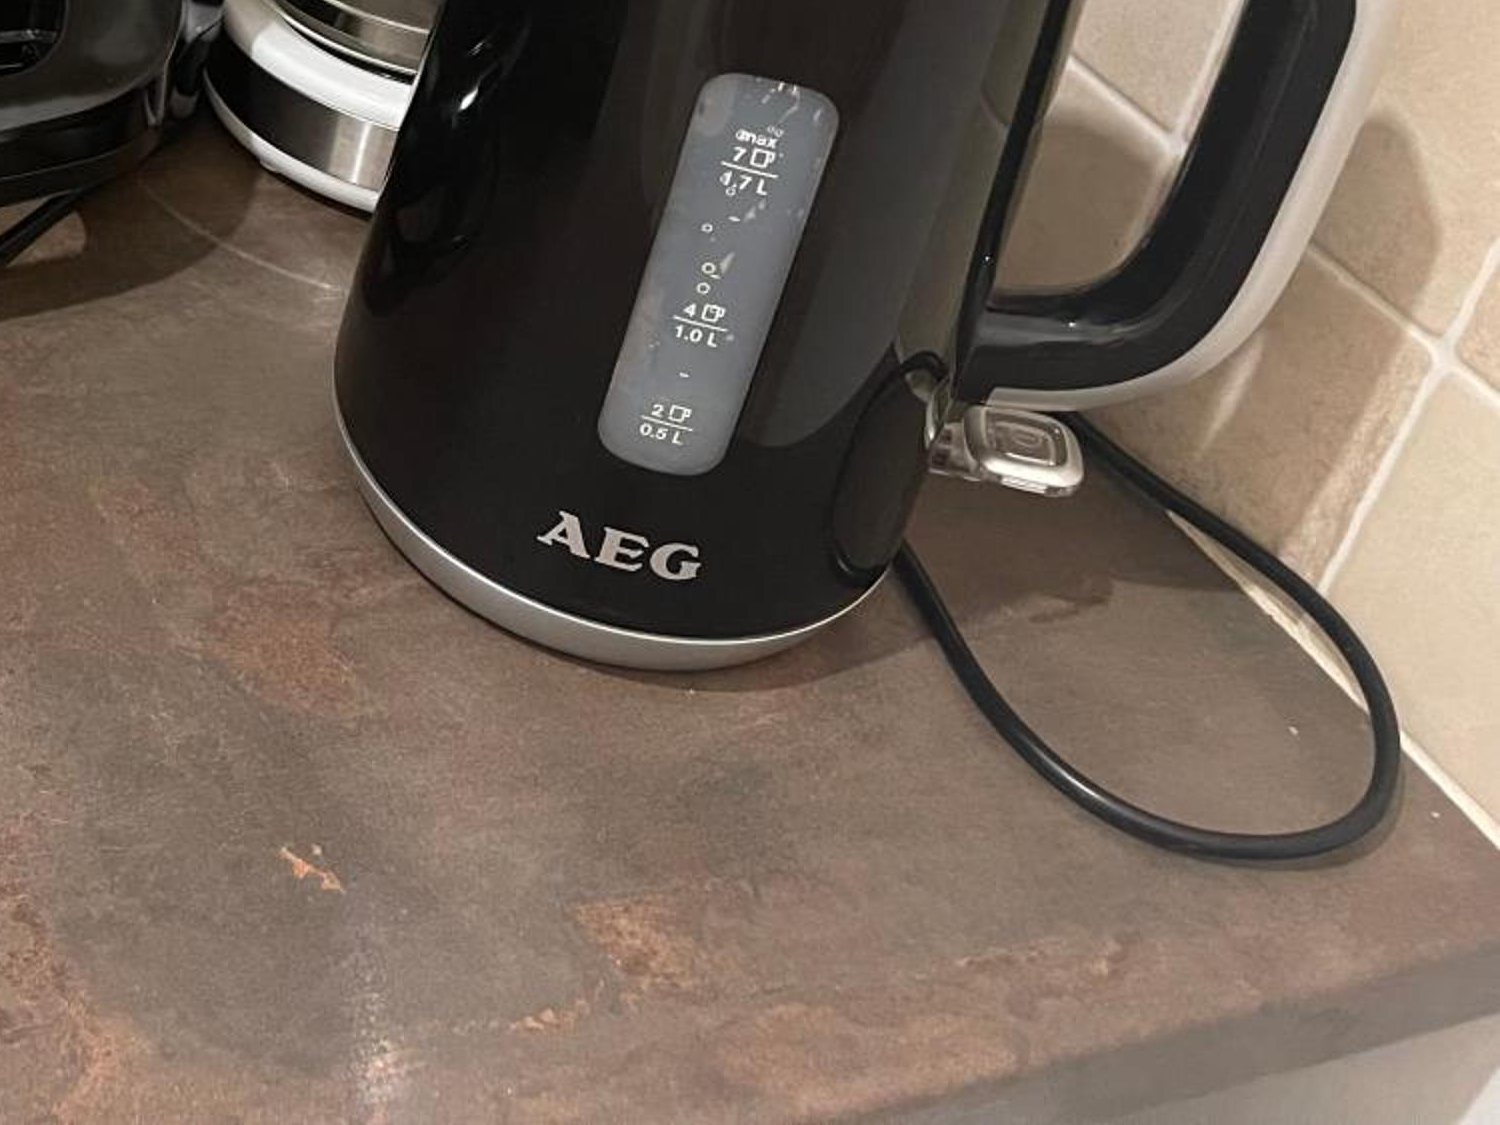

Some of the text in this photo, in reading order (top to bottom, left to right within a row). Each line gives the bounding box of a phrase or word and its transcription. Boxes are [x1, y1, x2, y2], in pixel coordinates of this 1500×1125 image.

[738, 129, 778, 149] max
[733, 146, 747, 162] 7
[756, 178, 768, 196] L
[683, 303, 697, 317] 4
[675, 325, 717, 348] 1.0 L
[651, 404, 664, 418] 2
[640, 423, 684, 446] 0.5 L
[536, 510, 702, 581] AEG
